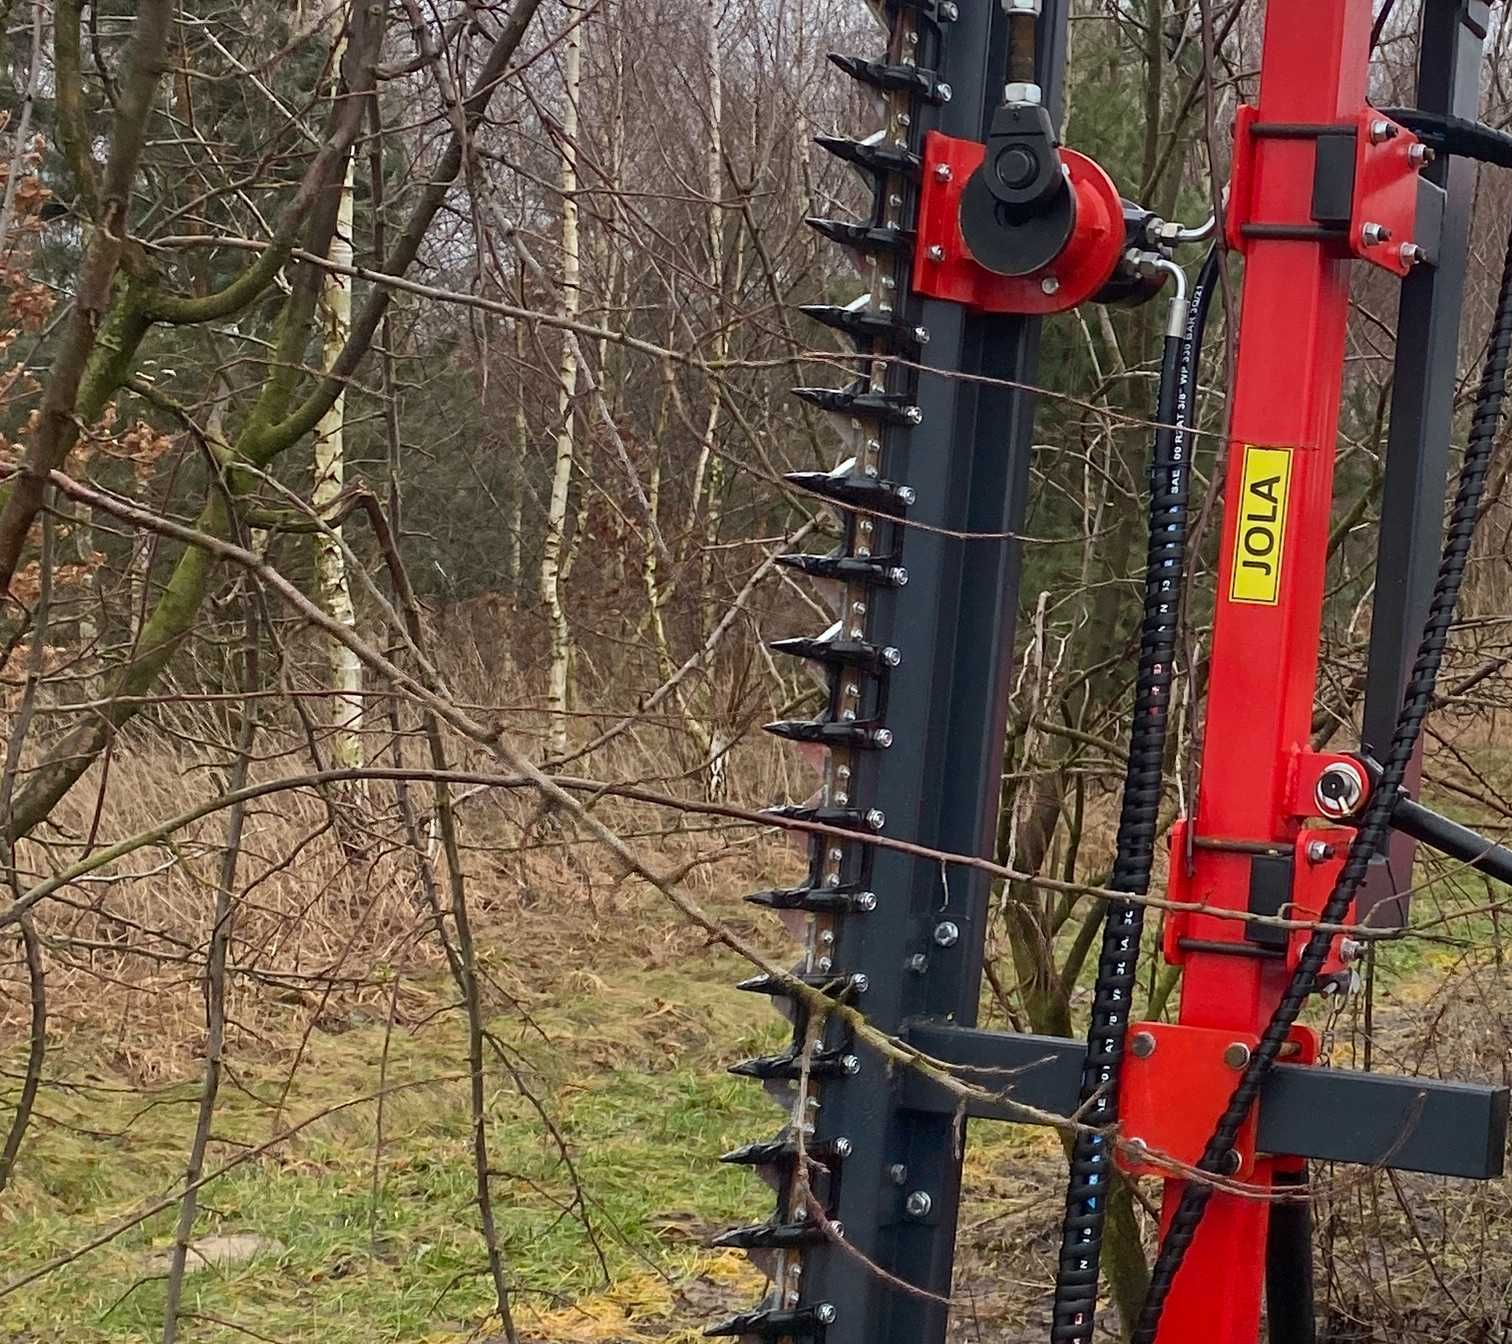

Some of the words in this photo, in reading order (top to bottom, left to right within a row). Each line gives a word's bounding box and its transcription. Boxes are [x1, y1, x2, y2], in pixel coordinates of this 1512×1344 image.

[1183, 343, 1192, 364] 330
[1180, 365, 1189, 385] WP
[1171, 469, 1181, 494] SAE
[1242, 475, 1281, 576] JOLA
